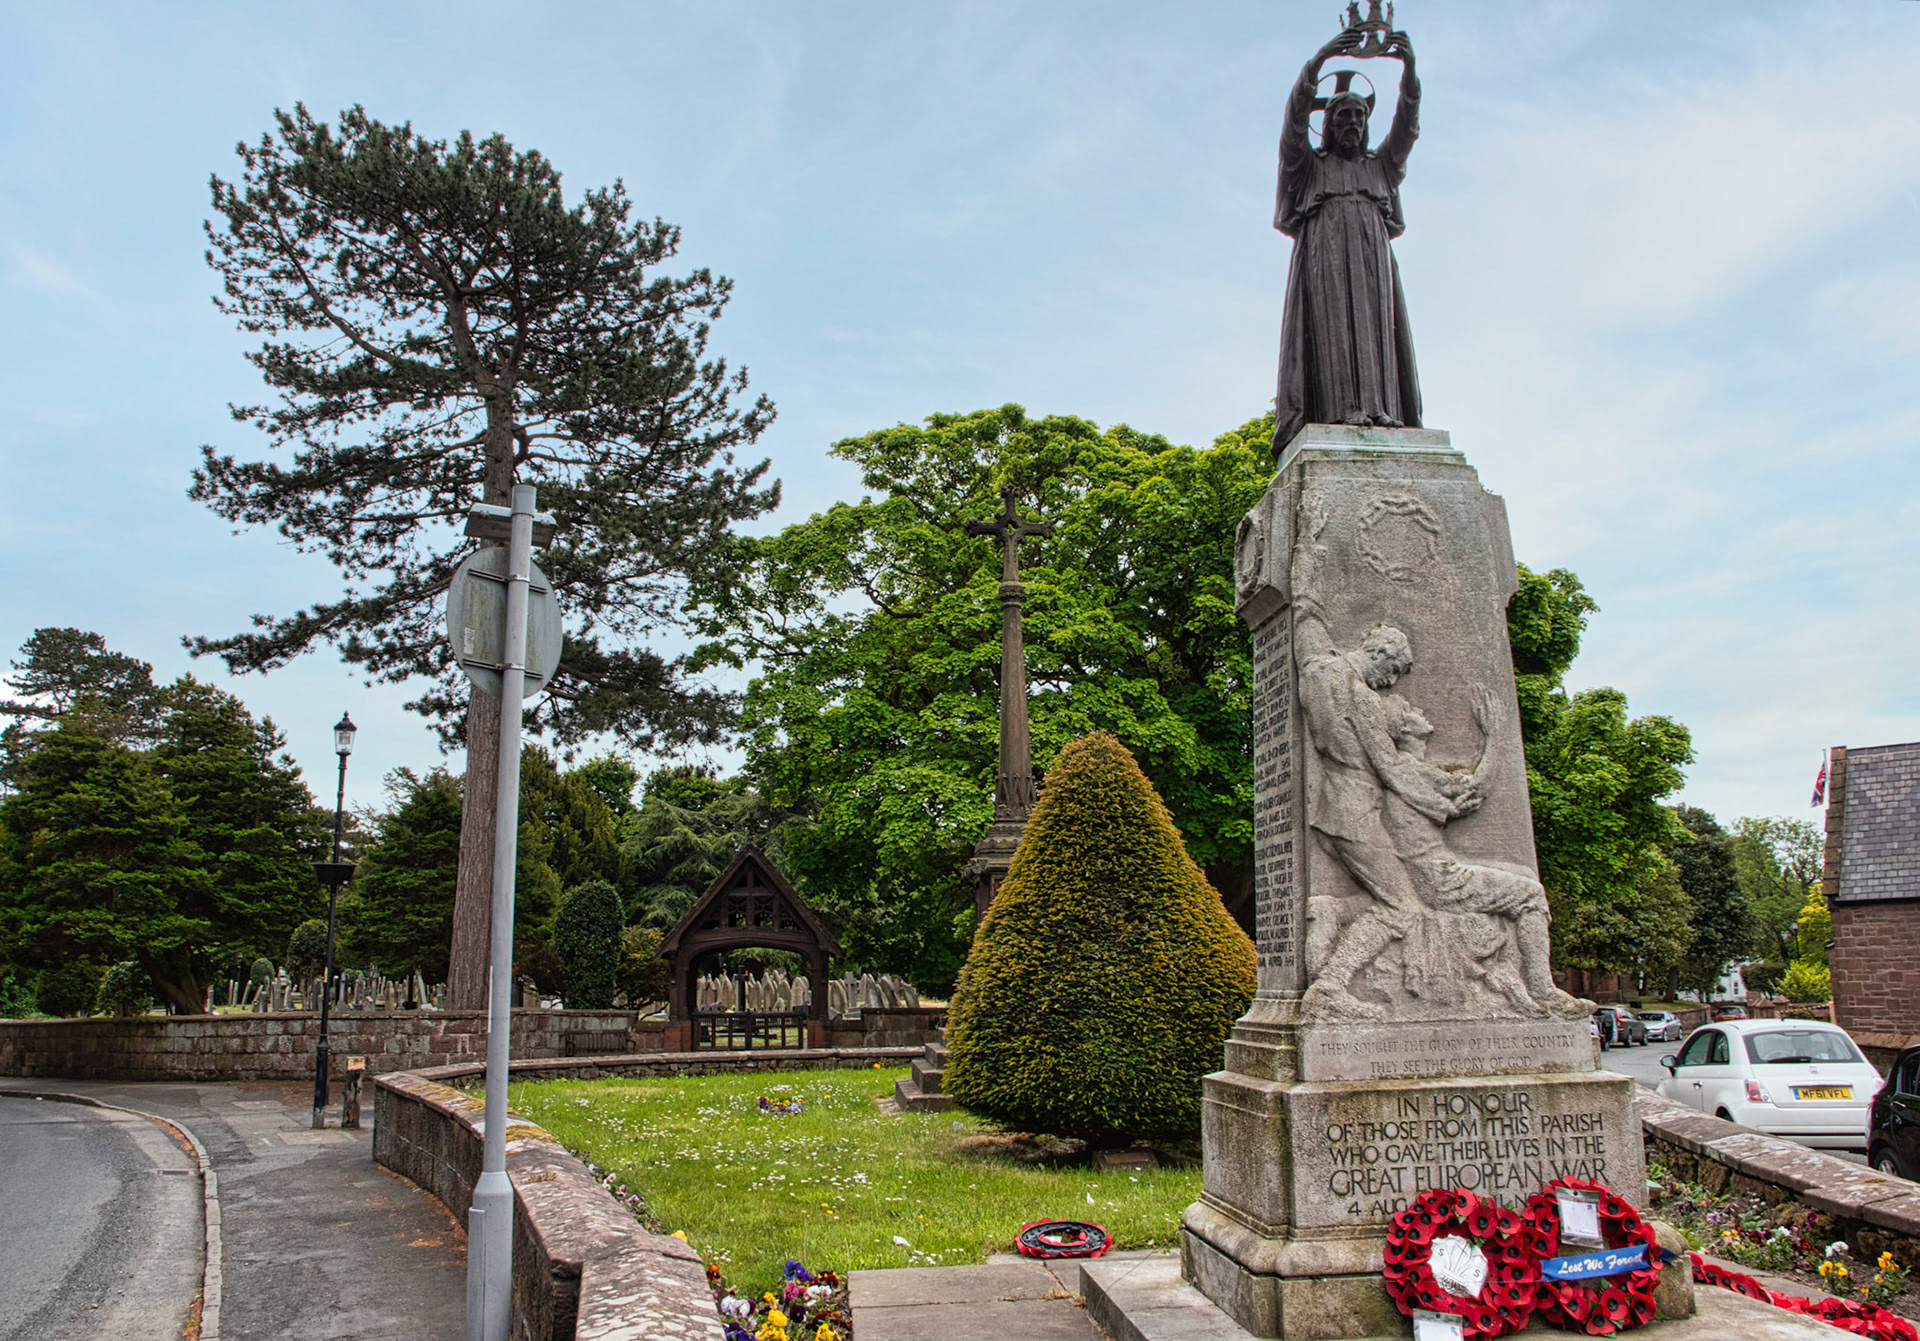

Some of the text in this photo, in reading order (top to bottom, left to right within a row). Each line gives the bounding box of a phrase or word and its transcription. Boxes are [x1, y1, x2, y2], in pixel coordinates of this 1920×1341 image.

[1320, 1034, 1576, 1055] THEY SOUGHT THE GLORY OF THEIR COUNTRY
[1370, 1056, 1532, 1073] THEY SEE THE GLORY OF GOD
[1397, 1092, 1533, 1117] IN HONOUR
[1326, 1112, 1604, 1142] OF THOSE FROM THIS PARISH
[1328, 1135, 1606, 1165] WHO GAVE THEIR LIVES IN THE
[1329, 1157, 1609, 1196] GREAT EUROPEAN WAR
[1347, 1201, 1362, 1217] 4
[1371, 1198, 1408, 1216] AUG
[1557, 1260, 1584, 1275] Lest
[1582, 1259, 1604, 1272] We
